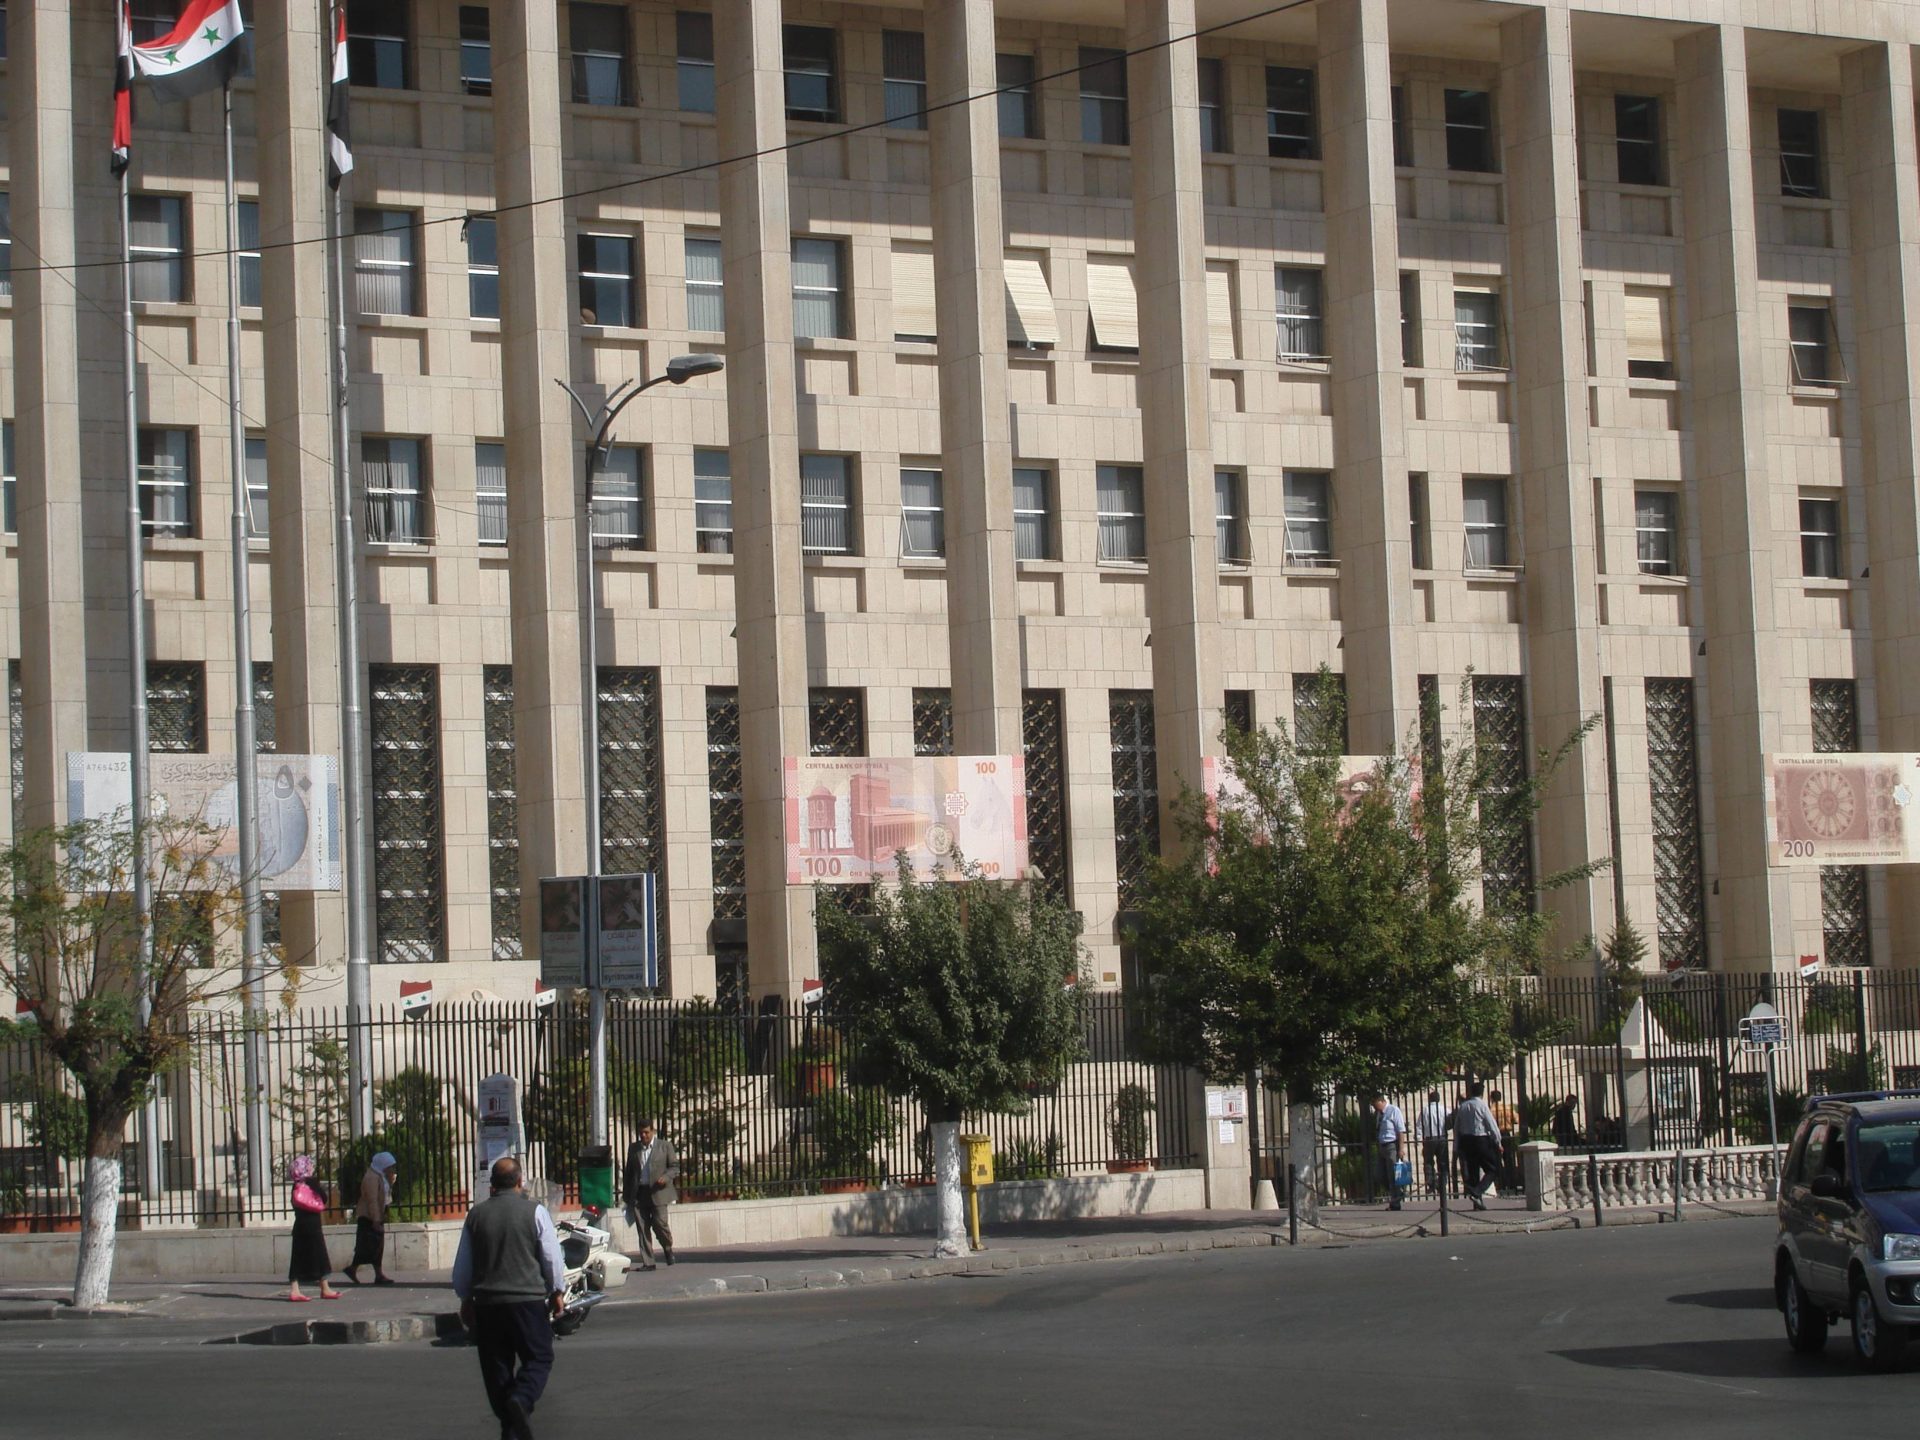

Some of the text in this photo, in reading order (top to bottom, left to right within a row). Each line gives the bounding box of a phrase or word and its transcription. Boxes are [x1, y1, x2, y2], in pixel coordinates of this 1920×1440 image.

[975, 761, 996, 774] 100
[1783, 841, 1814, 858] 200
[805, 857, 841, 876] 100
